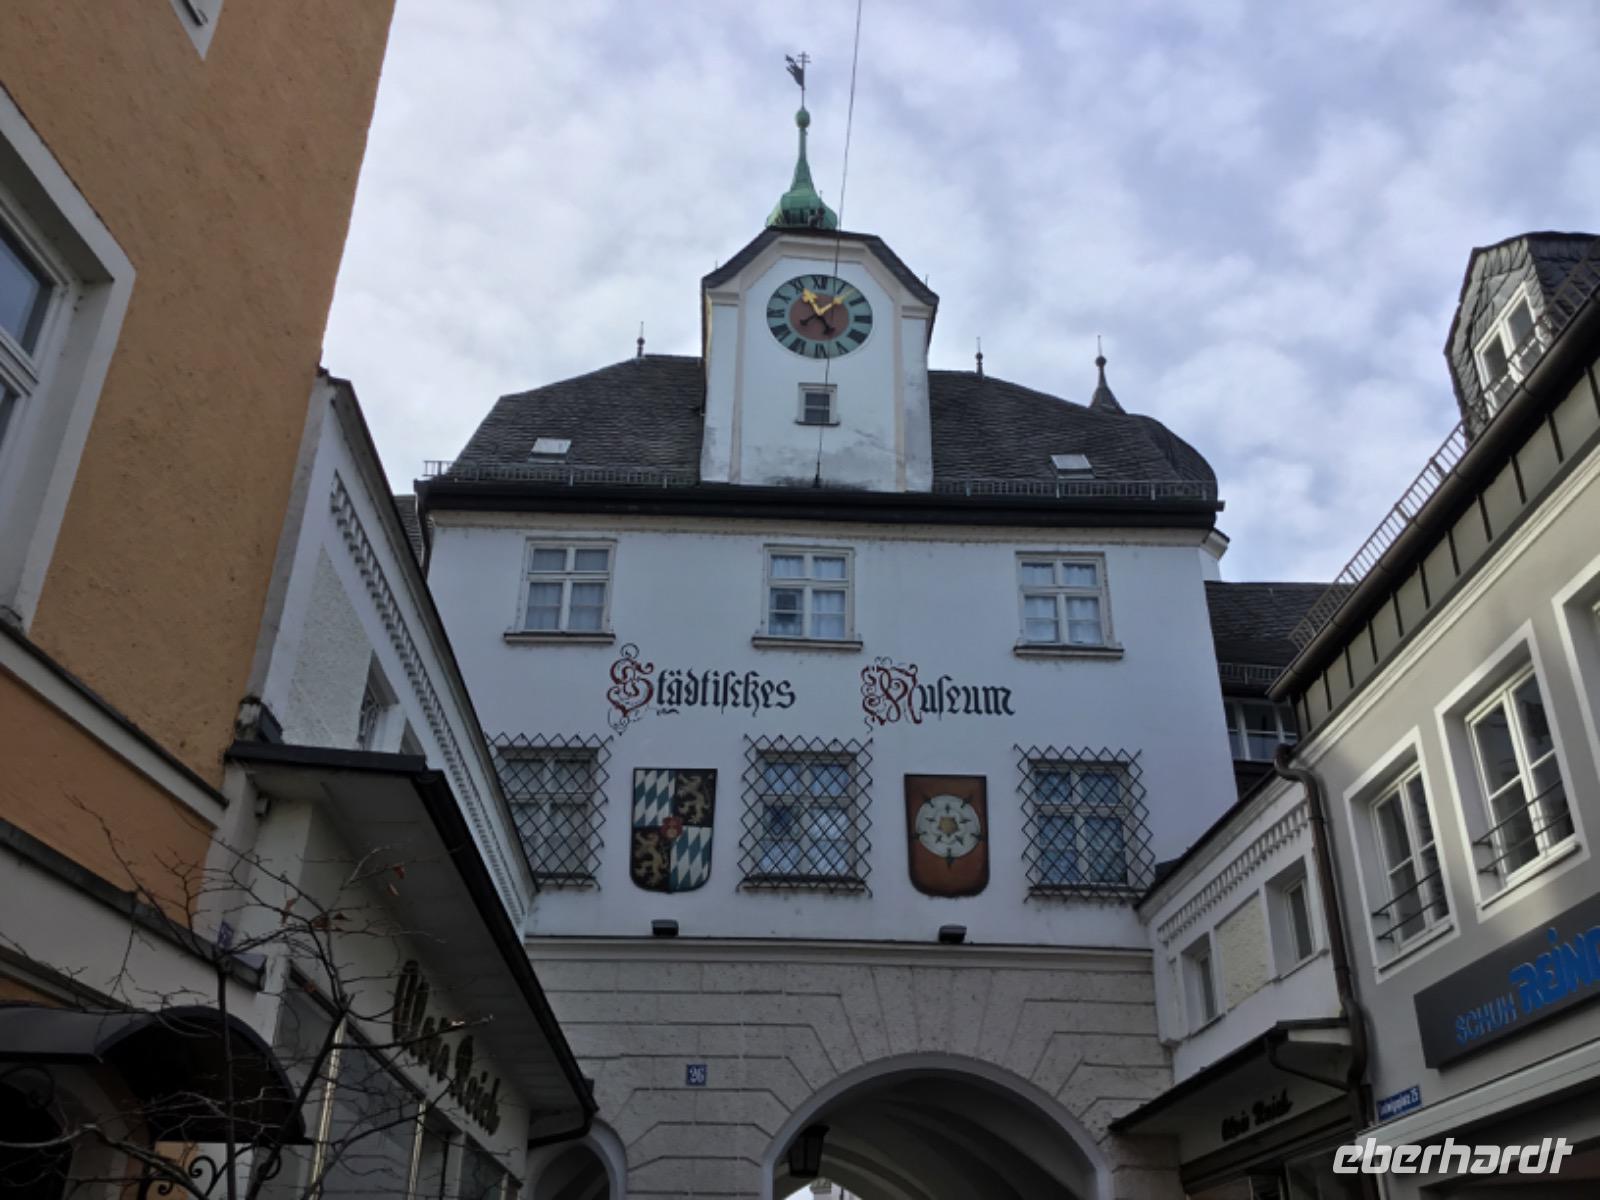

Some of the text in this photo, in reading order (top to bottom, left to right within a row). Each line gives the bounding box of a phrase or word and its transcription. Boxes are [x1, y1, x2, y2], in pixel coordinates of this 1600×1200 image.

[607, 648, 1017, 728] Städtisches Museum
[1456, 992, 1518, 1046] SCHUH
